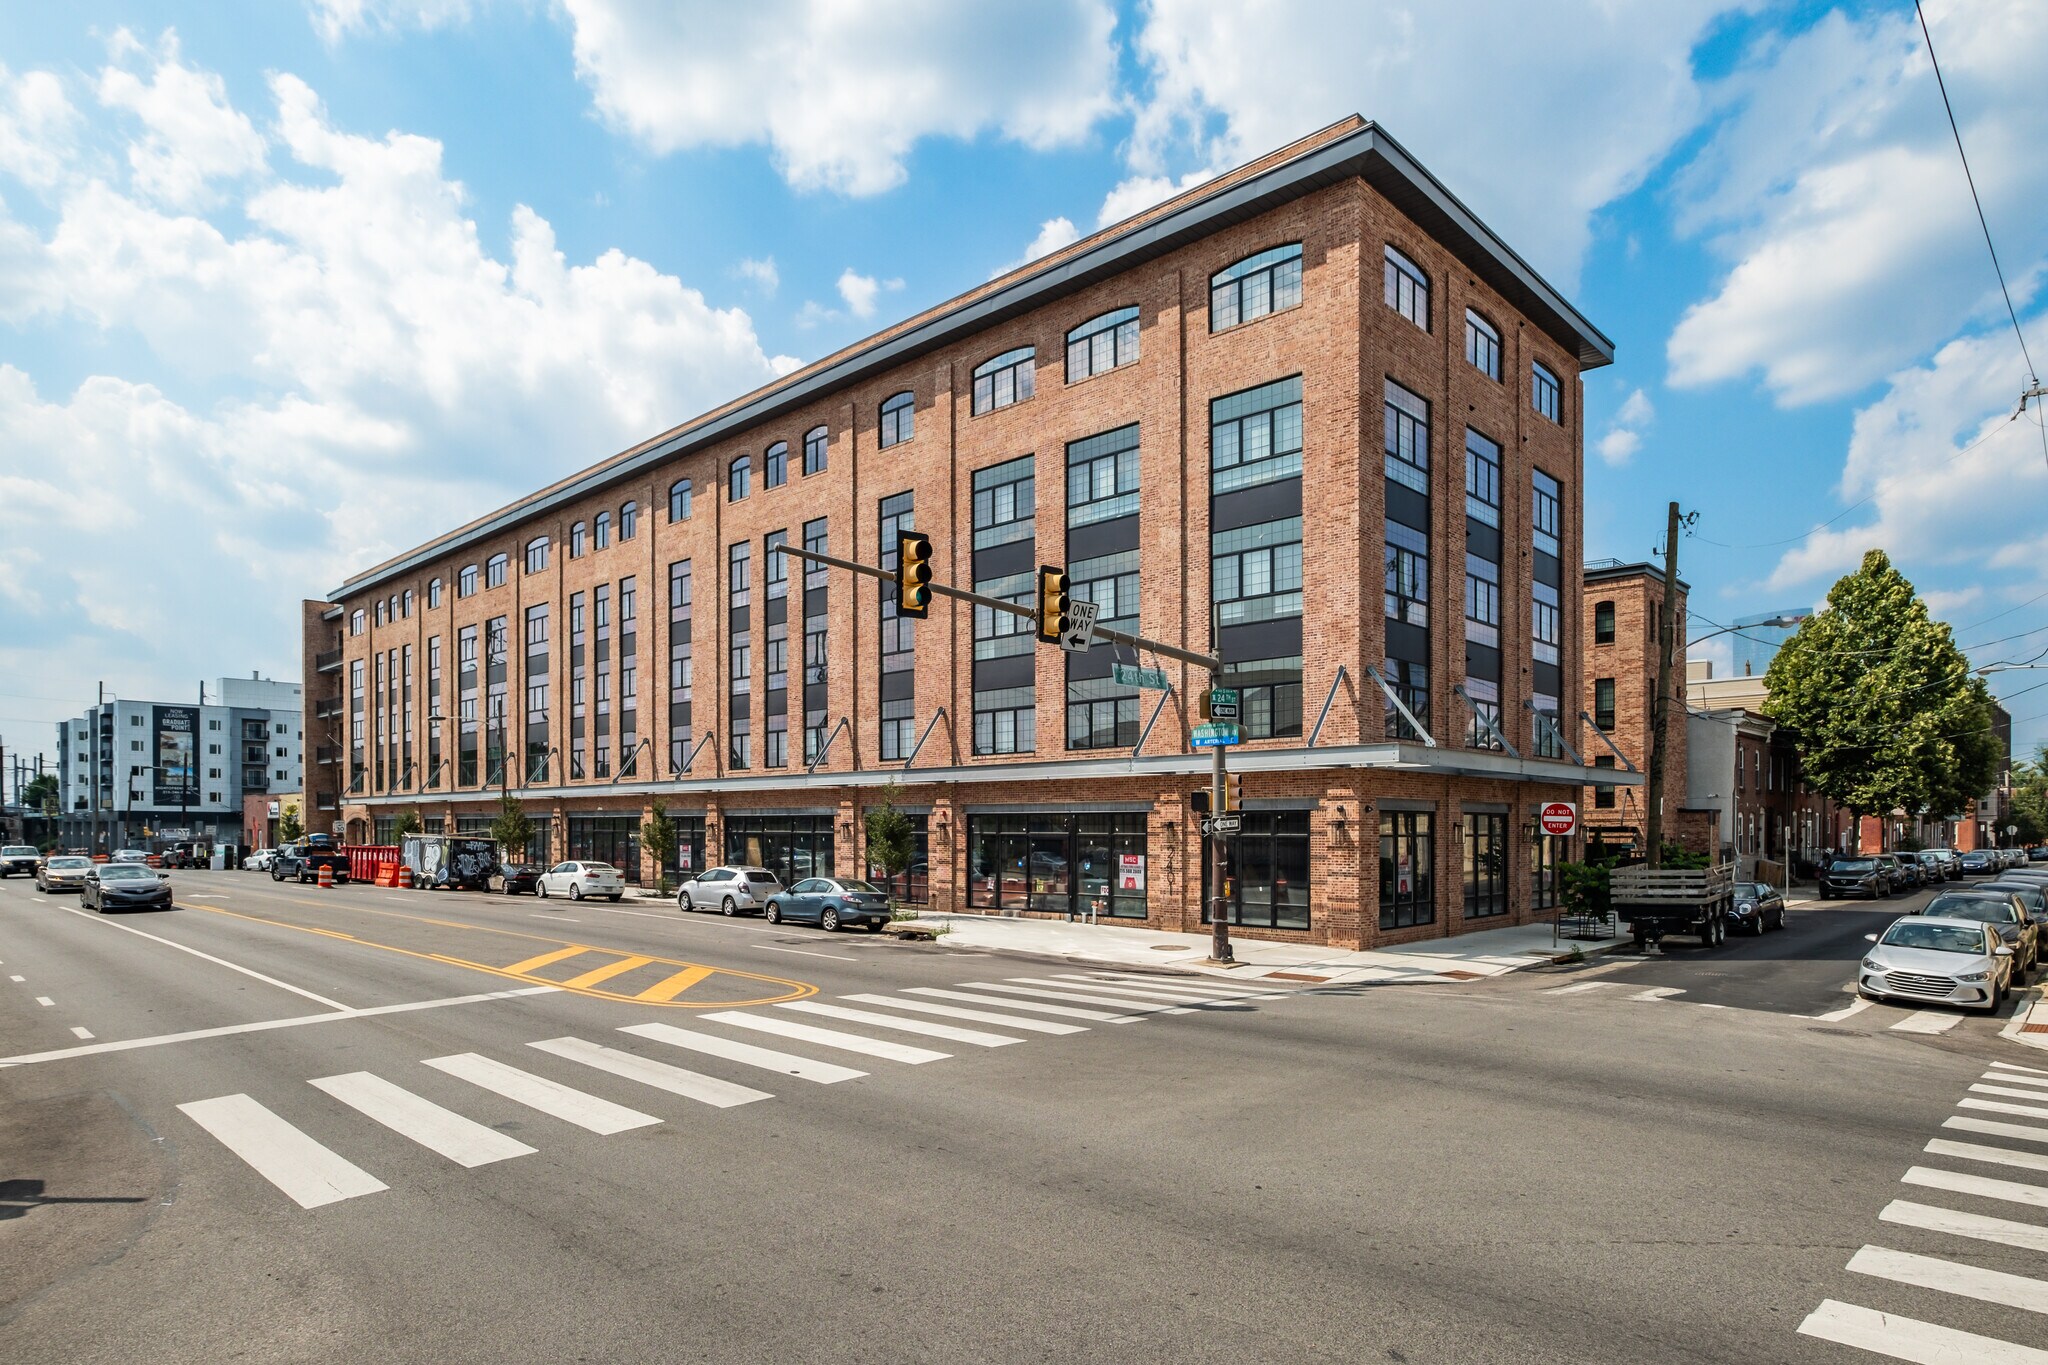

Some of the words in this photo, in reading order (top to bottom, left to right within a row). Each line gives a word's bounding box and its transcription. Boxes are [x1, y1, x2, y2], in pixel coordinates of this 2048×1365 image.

[1073, 604, 1094, 618] ONE
[1070, 617, 1091, 632] WAY
[1120, 669, 1145, 684] 24th
[1148, 673, 1160, 685] St
[1193, 727, 1229, 738] WASHINGTON
